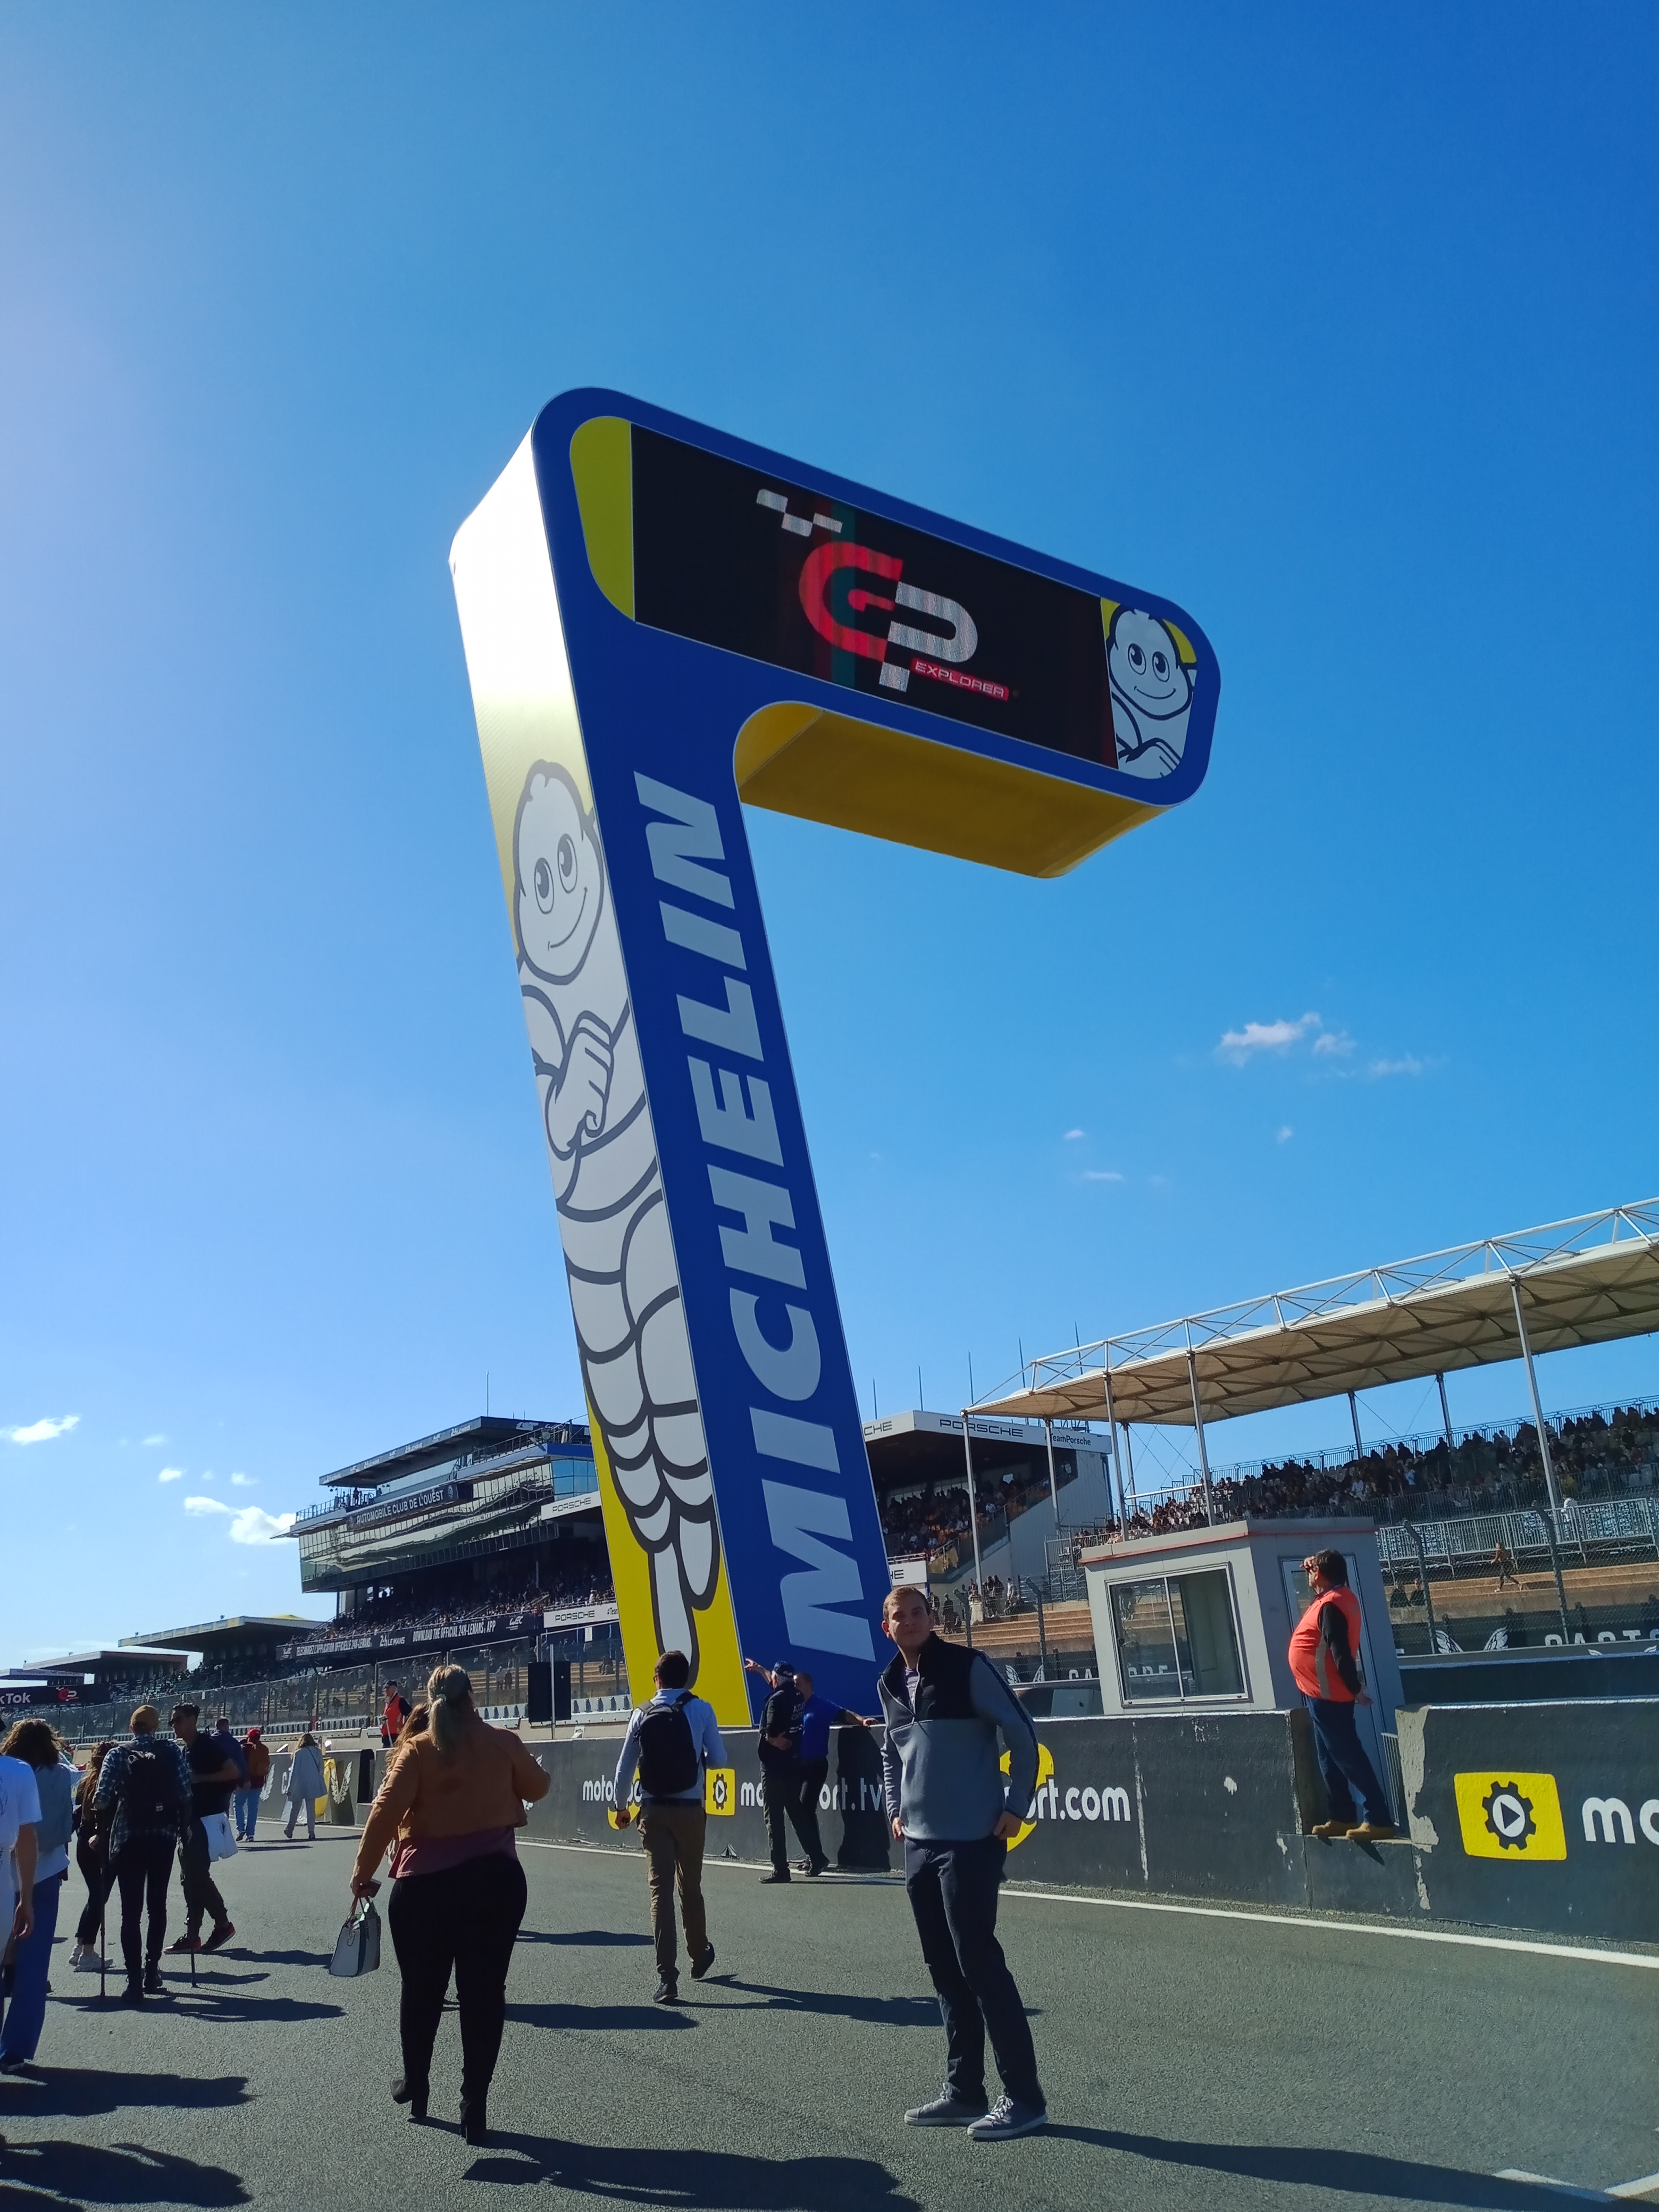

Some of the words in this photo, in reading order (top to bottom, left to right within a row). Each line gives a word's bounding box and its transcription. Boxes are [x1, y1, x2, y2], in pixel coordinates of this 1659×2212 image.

[915, 660, 1004, 697] EXPLORER
[634, 772, 876, 1663] MICHELIN
[940, 1419, 1024, 1437] PORSCHE
[1045, 1434, 1091, 1446] eamPorsche
[356, 1505, 392, 1525] AUTOMOBILE
[392, 1502, 408, 1514] CLUB
[409, 1497, 418, 1510] DE
[418, 1489, 444, 1507] L'OUEST
[552, 1497, 591, 1513] PORSCHE
[555, 1610, 596, 1622] PORSCHE
[413, 1629, 433, 1643] DOWNLOAD
[440, 1626, 458, 1639] OFFICIAL
[486, 1620, 496, 1633] APP
